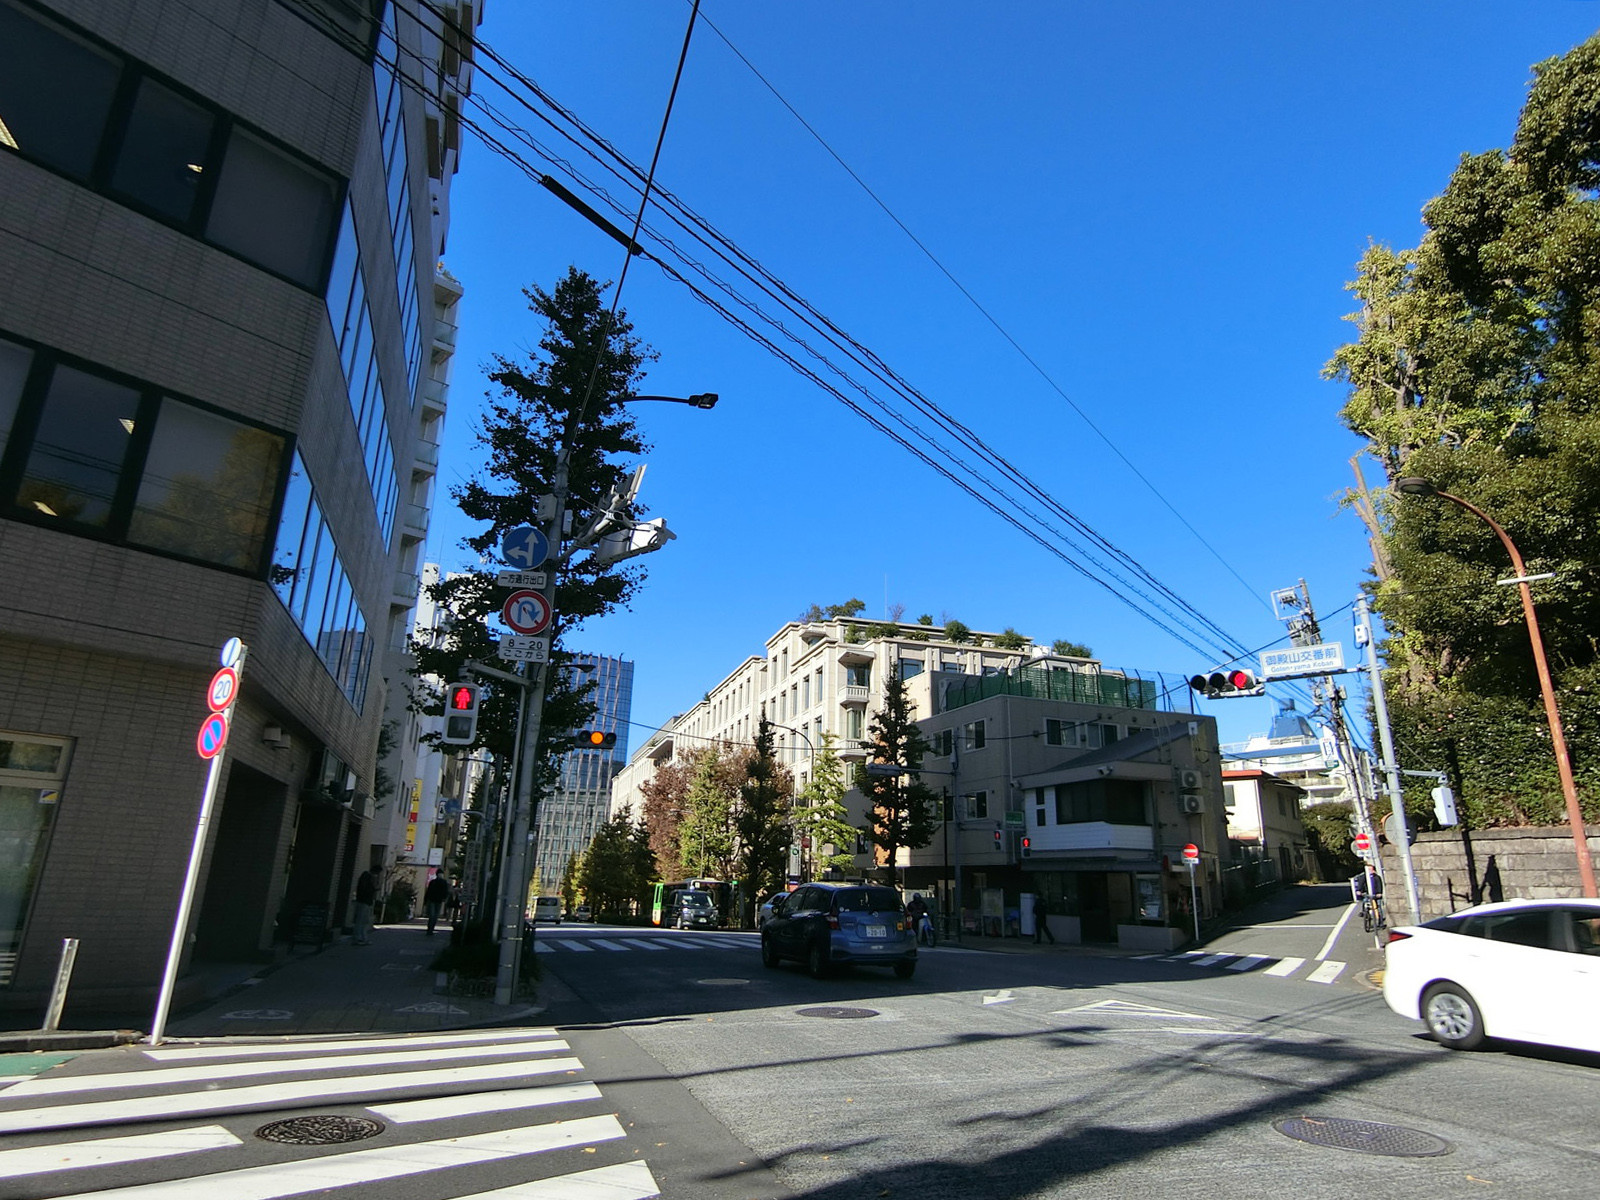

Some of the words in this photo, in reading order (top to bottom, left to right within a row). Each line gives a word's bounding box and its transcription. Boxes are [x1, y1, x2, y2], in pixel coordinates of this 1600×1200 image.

[501, 574, 544, 585] 一方通行出口
[503, 649, 544, 660] ここから
[1265, 647, 1337, 666] 御殿山交番前
[214, 679, 231, 700] 20
